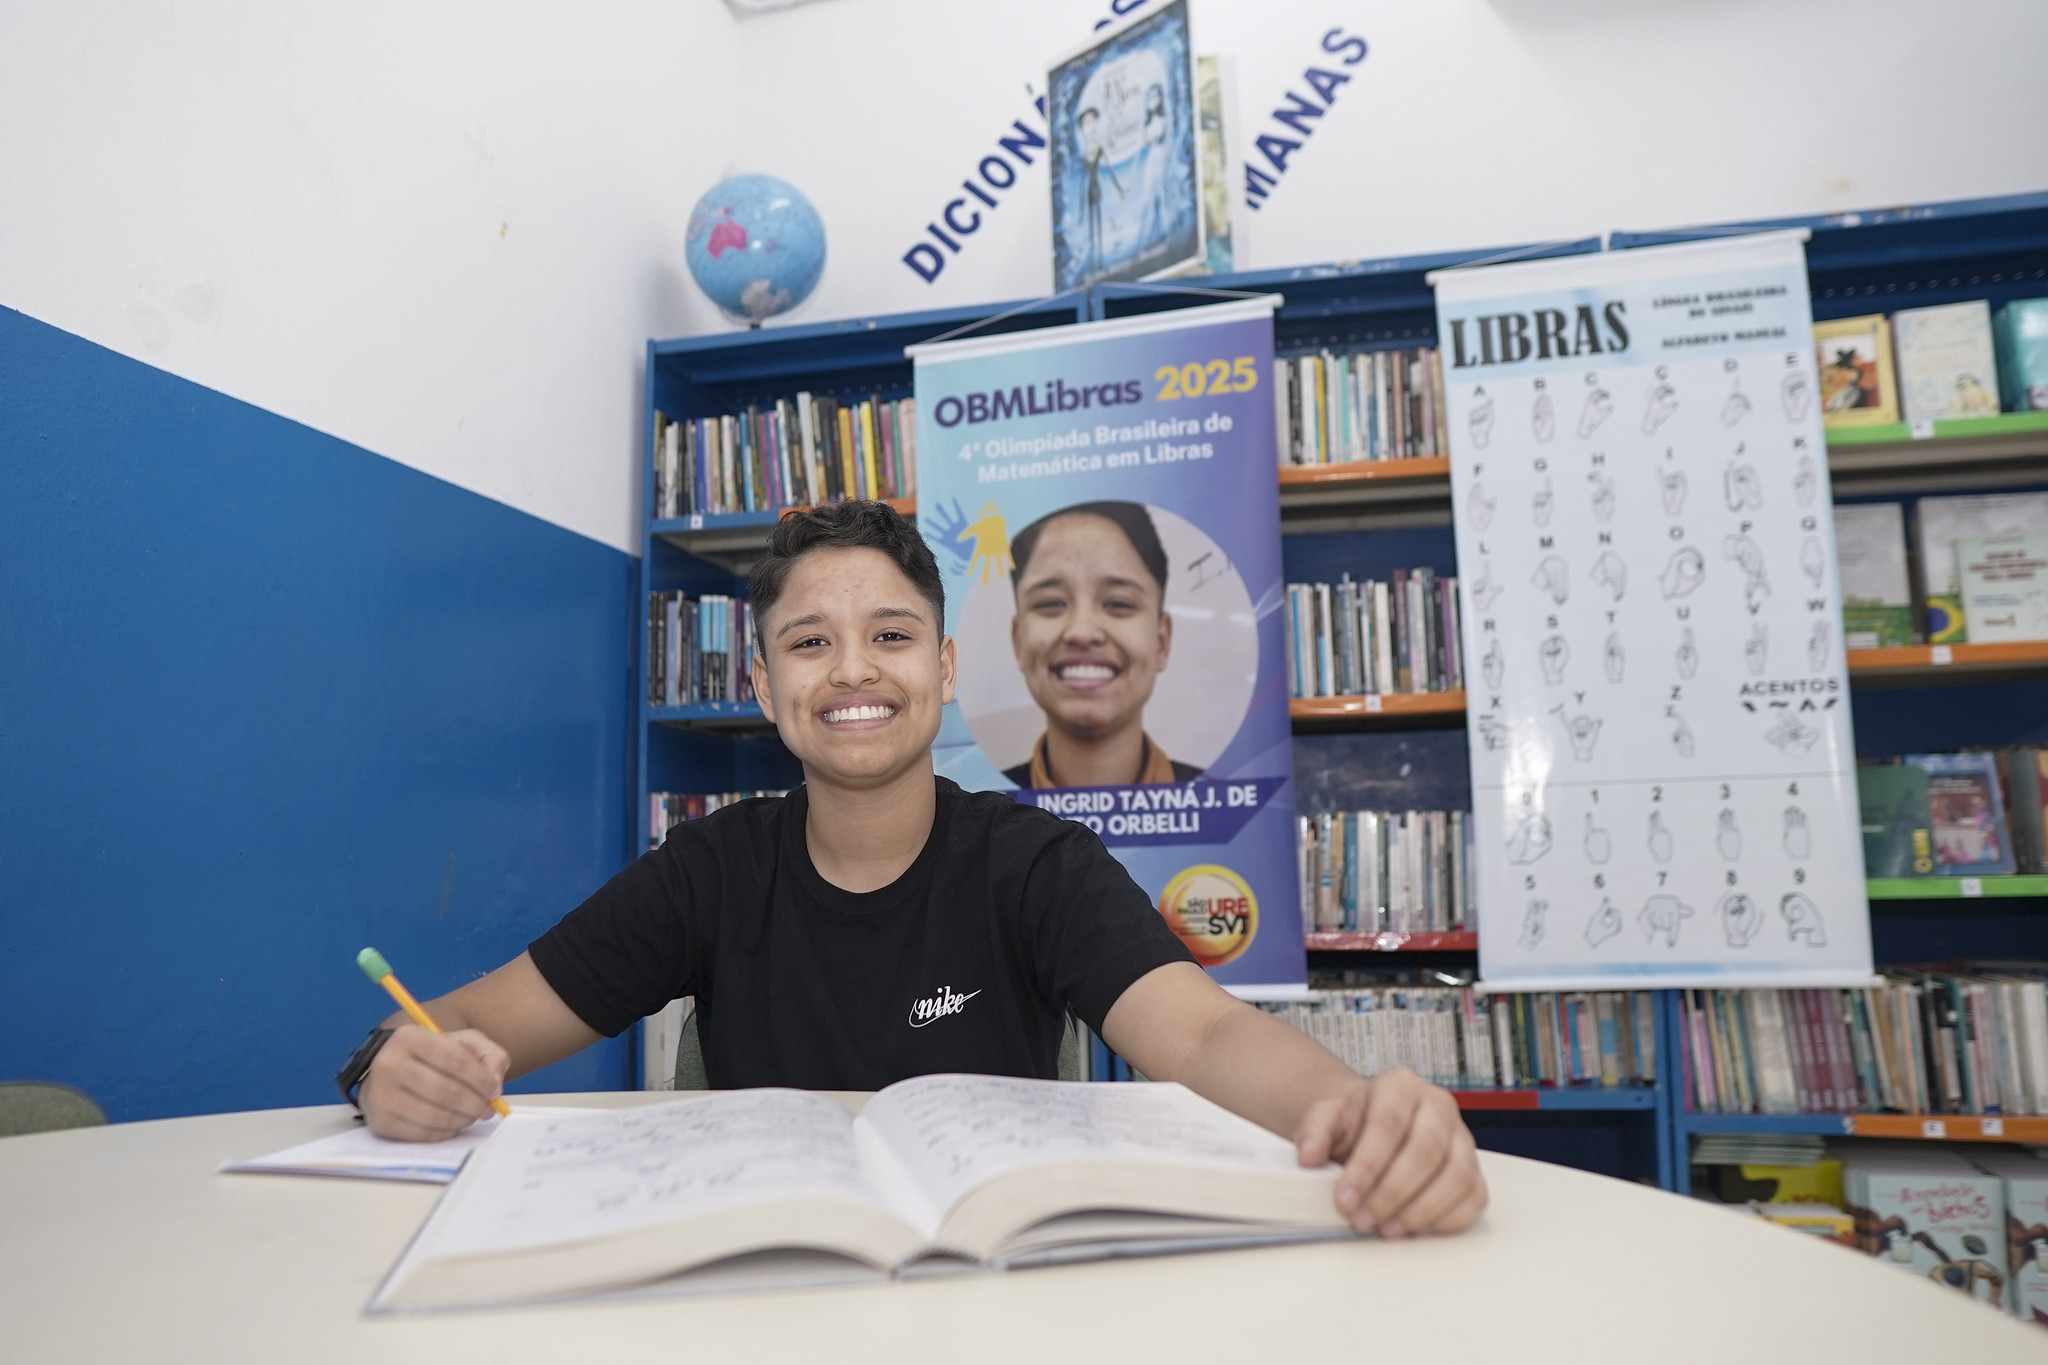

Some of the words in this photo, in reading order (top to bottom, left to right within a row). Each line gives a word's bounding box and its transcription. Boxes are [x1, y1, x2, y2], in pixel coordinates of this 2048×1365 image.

[1450, 299, 1631, 369] LIBRAS
[934, 378, 1143, 428] OBMLibras
[1154, 356, 1258, 402] 2025
[985, 430, 1092, 461] Olimpíada
[1095, 417, 1200, 446] Brasileira
[1204, 412, 1233, 434] de
[977, 457, 1102, 485] Matemática
[1106, 450, 1141, 469] em
[1145, 441, 1214, 466] Libras
[1738, 677, 1841, 697] ACENTOS
[1036, 792, 1116, 815] INGRID
[1117, 781, 1199, 812] TAYNÁ
[1202, 788, 1223, 809] J.
[1227, 785, 1258, 807] DE
[1107, 811, 1201, 836] ORBELLI
[1207, 897, 1249, 916] URE
